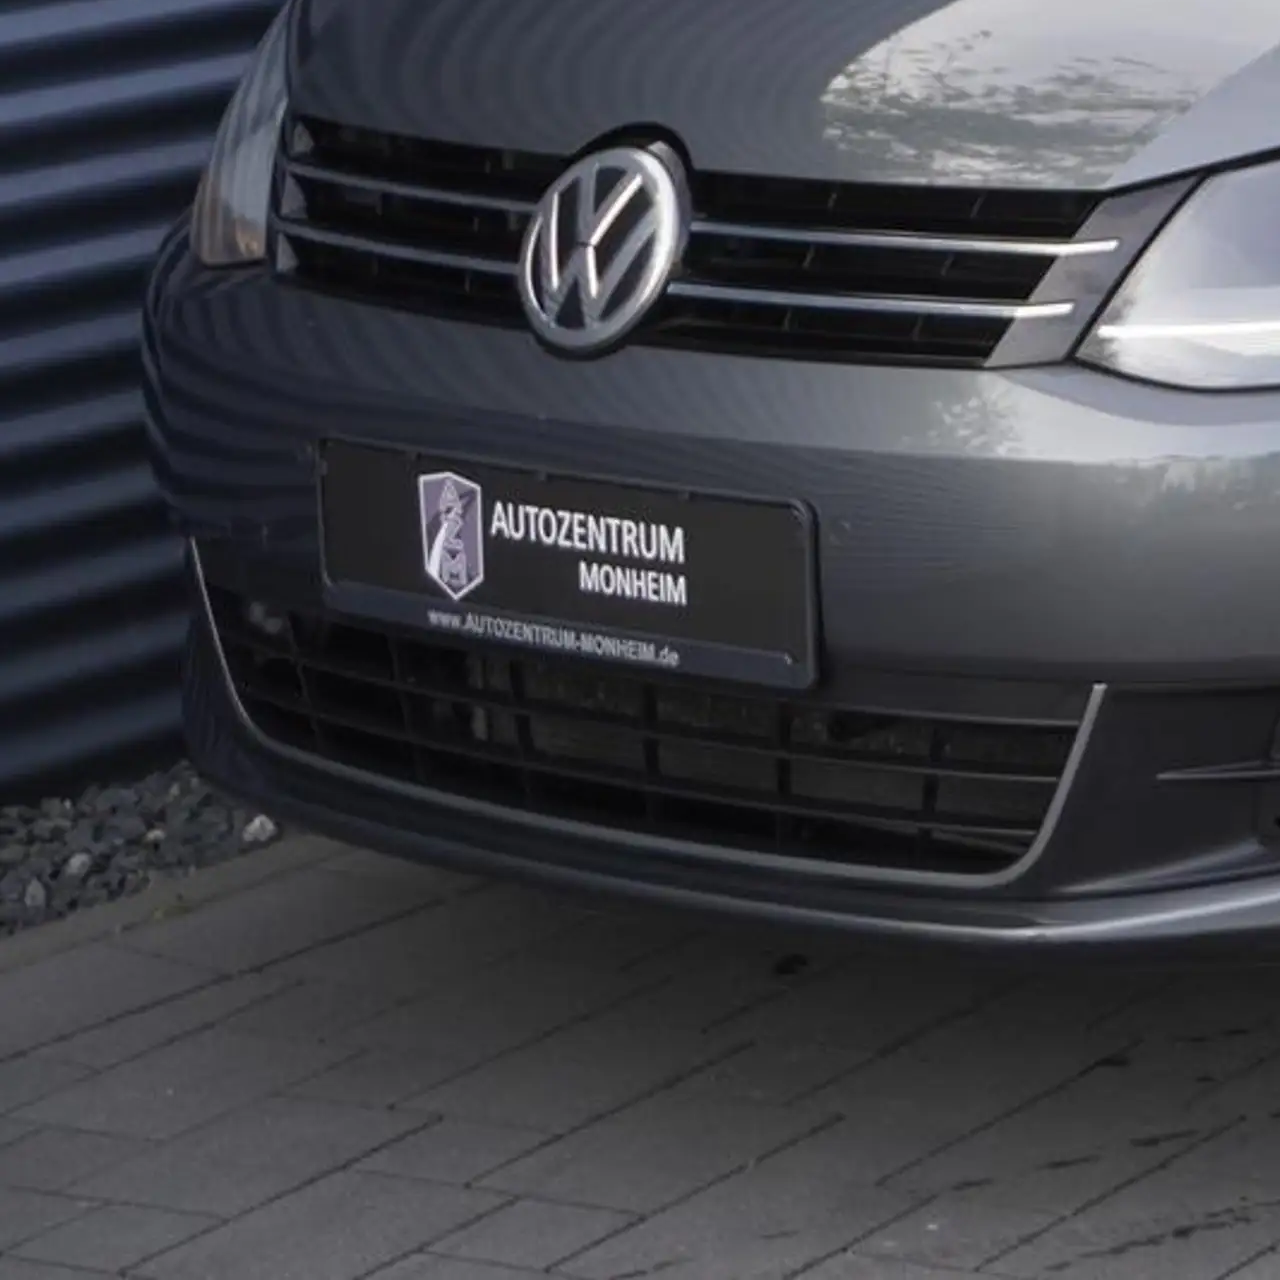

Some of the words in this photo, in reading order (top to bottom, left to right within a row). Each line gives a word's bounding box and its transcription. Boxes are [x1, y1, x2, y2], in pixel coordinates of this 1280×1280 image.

[521, 150, 674, 344] VW
[491, 501, 685, 564] AUTOZENTRUM
[579, 561, 687, 605] MONHEIM
[428, 610, 679, 666] www.AUTOZENTRUM-MONHEIM.de
